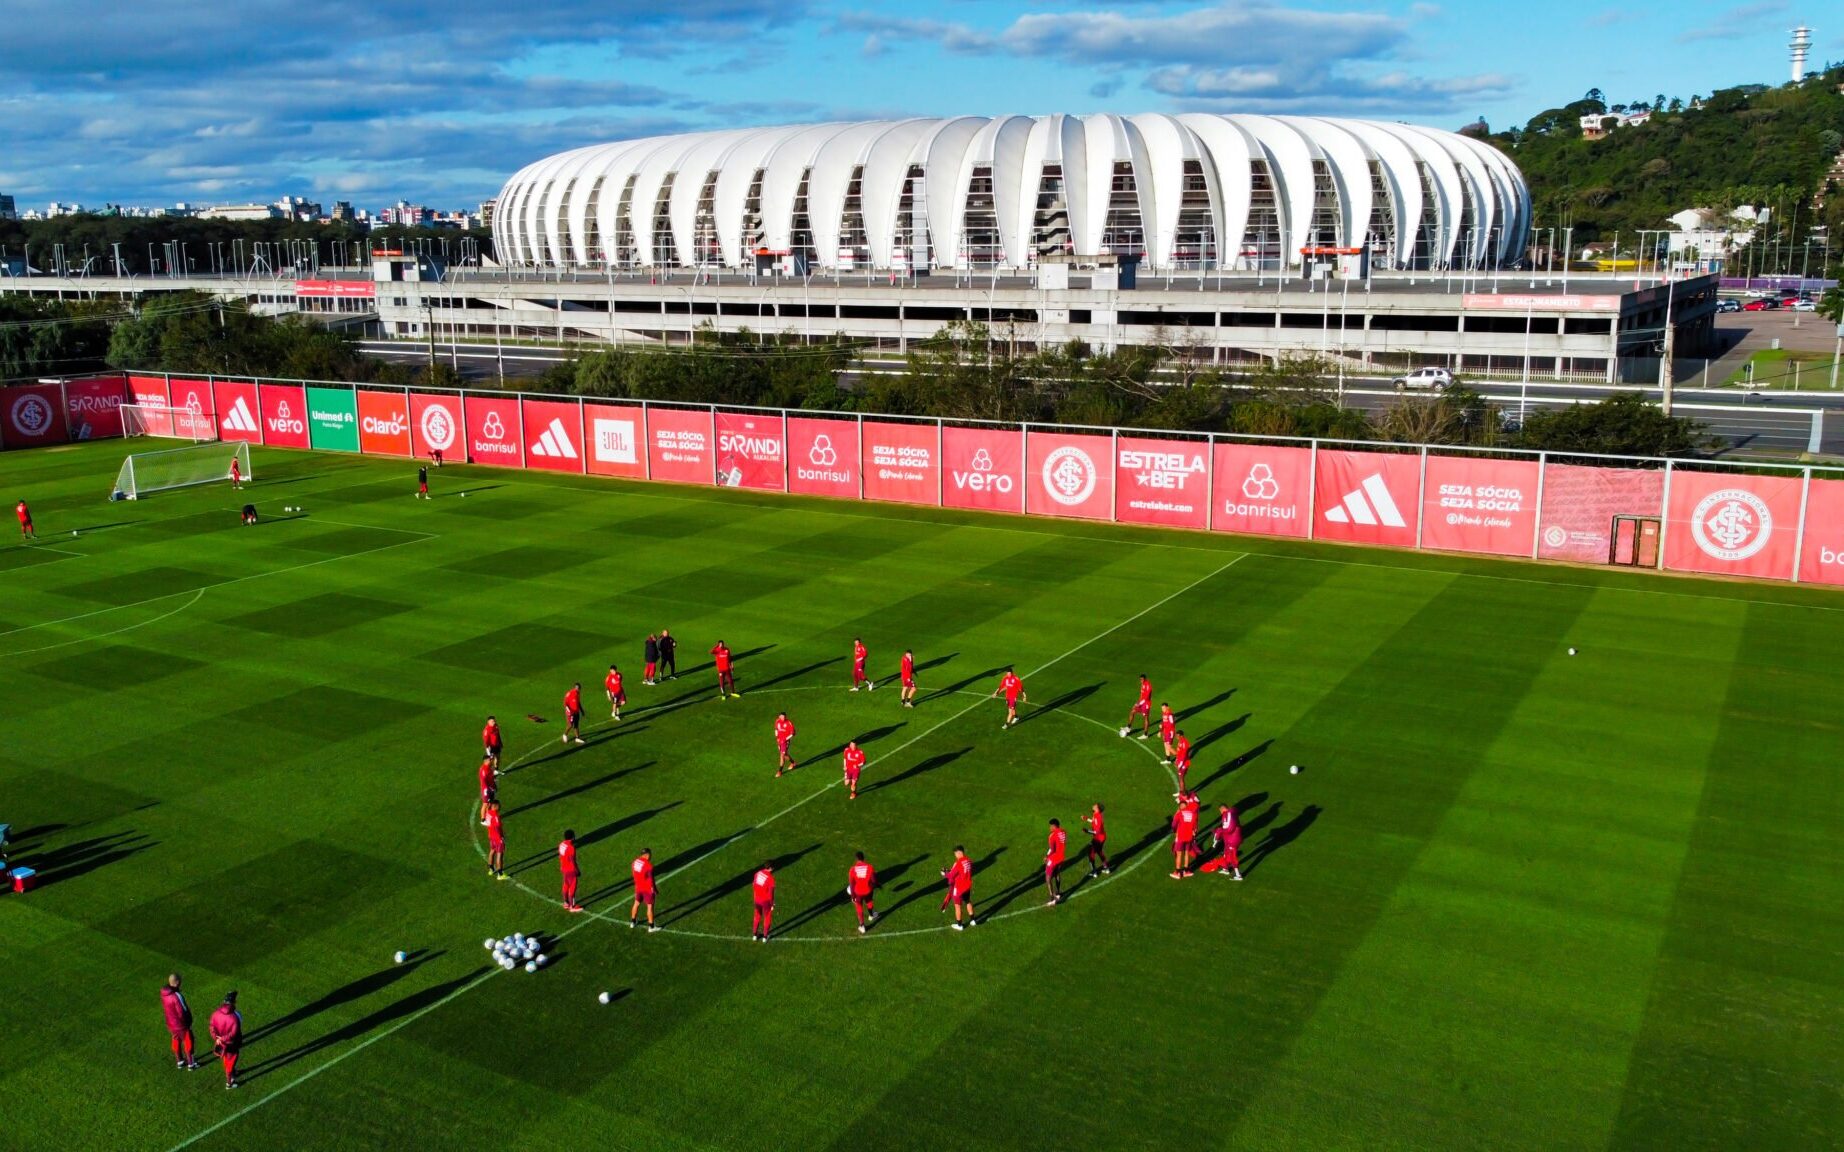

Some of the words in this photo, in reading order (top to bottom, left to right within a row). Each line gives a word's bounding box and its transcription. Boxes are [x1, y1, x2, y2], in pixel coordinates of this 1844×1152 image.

[69, 394, 124, 414] SARANDI
[312, 410, 343, 422] Unimed
[268, 417, 303, 434] vero
[363, 416, 401, 436] Claro
[602, 431, 628, 451] JBL
[656, 430, 676, 440] SEJA
[677, 431, 705, 443] SÓCIO,
[475, 439, 517, 454] banrisul
[658, 440, 678, 449] SEJA
[678, 440, 705, 451] SÓCIA
[719, 434, 781, 459] SARANDI
[872, 445, 896, 455] SEJA
[897, 446, 930, 459] SÓCIO,
[874, 455, 897, 466] SEJA
[898, 456, 929, 468] SÓCIA
[1119, 451, 1207, 473] ESTRELA
[798, 467, 850, 483] banrisul
[953, 471, 1013, 493] vero
[1150, 471, 1189, 490] BET
[1439, 484, 1473, 497] SEJA
[1475, 485, 1523, 501] SÓCIO,
[1130, 500, 1193, 513] estrelabet.com
[1225, 500, 1297, 519] banrisul
[1440, 497, 1473, 509] SEJA
[1477, 498, 1521, 512] SÓCIA
